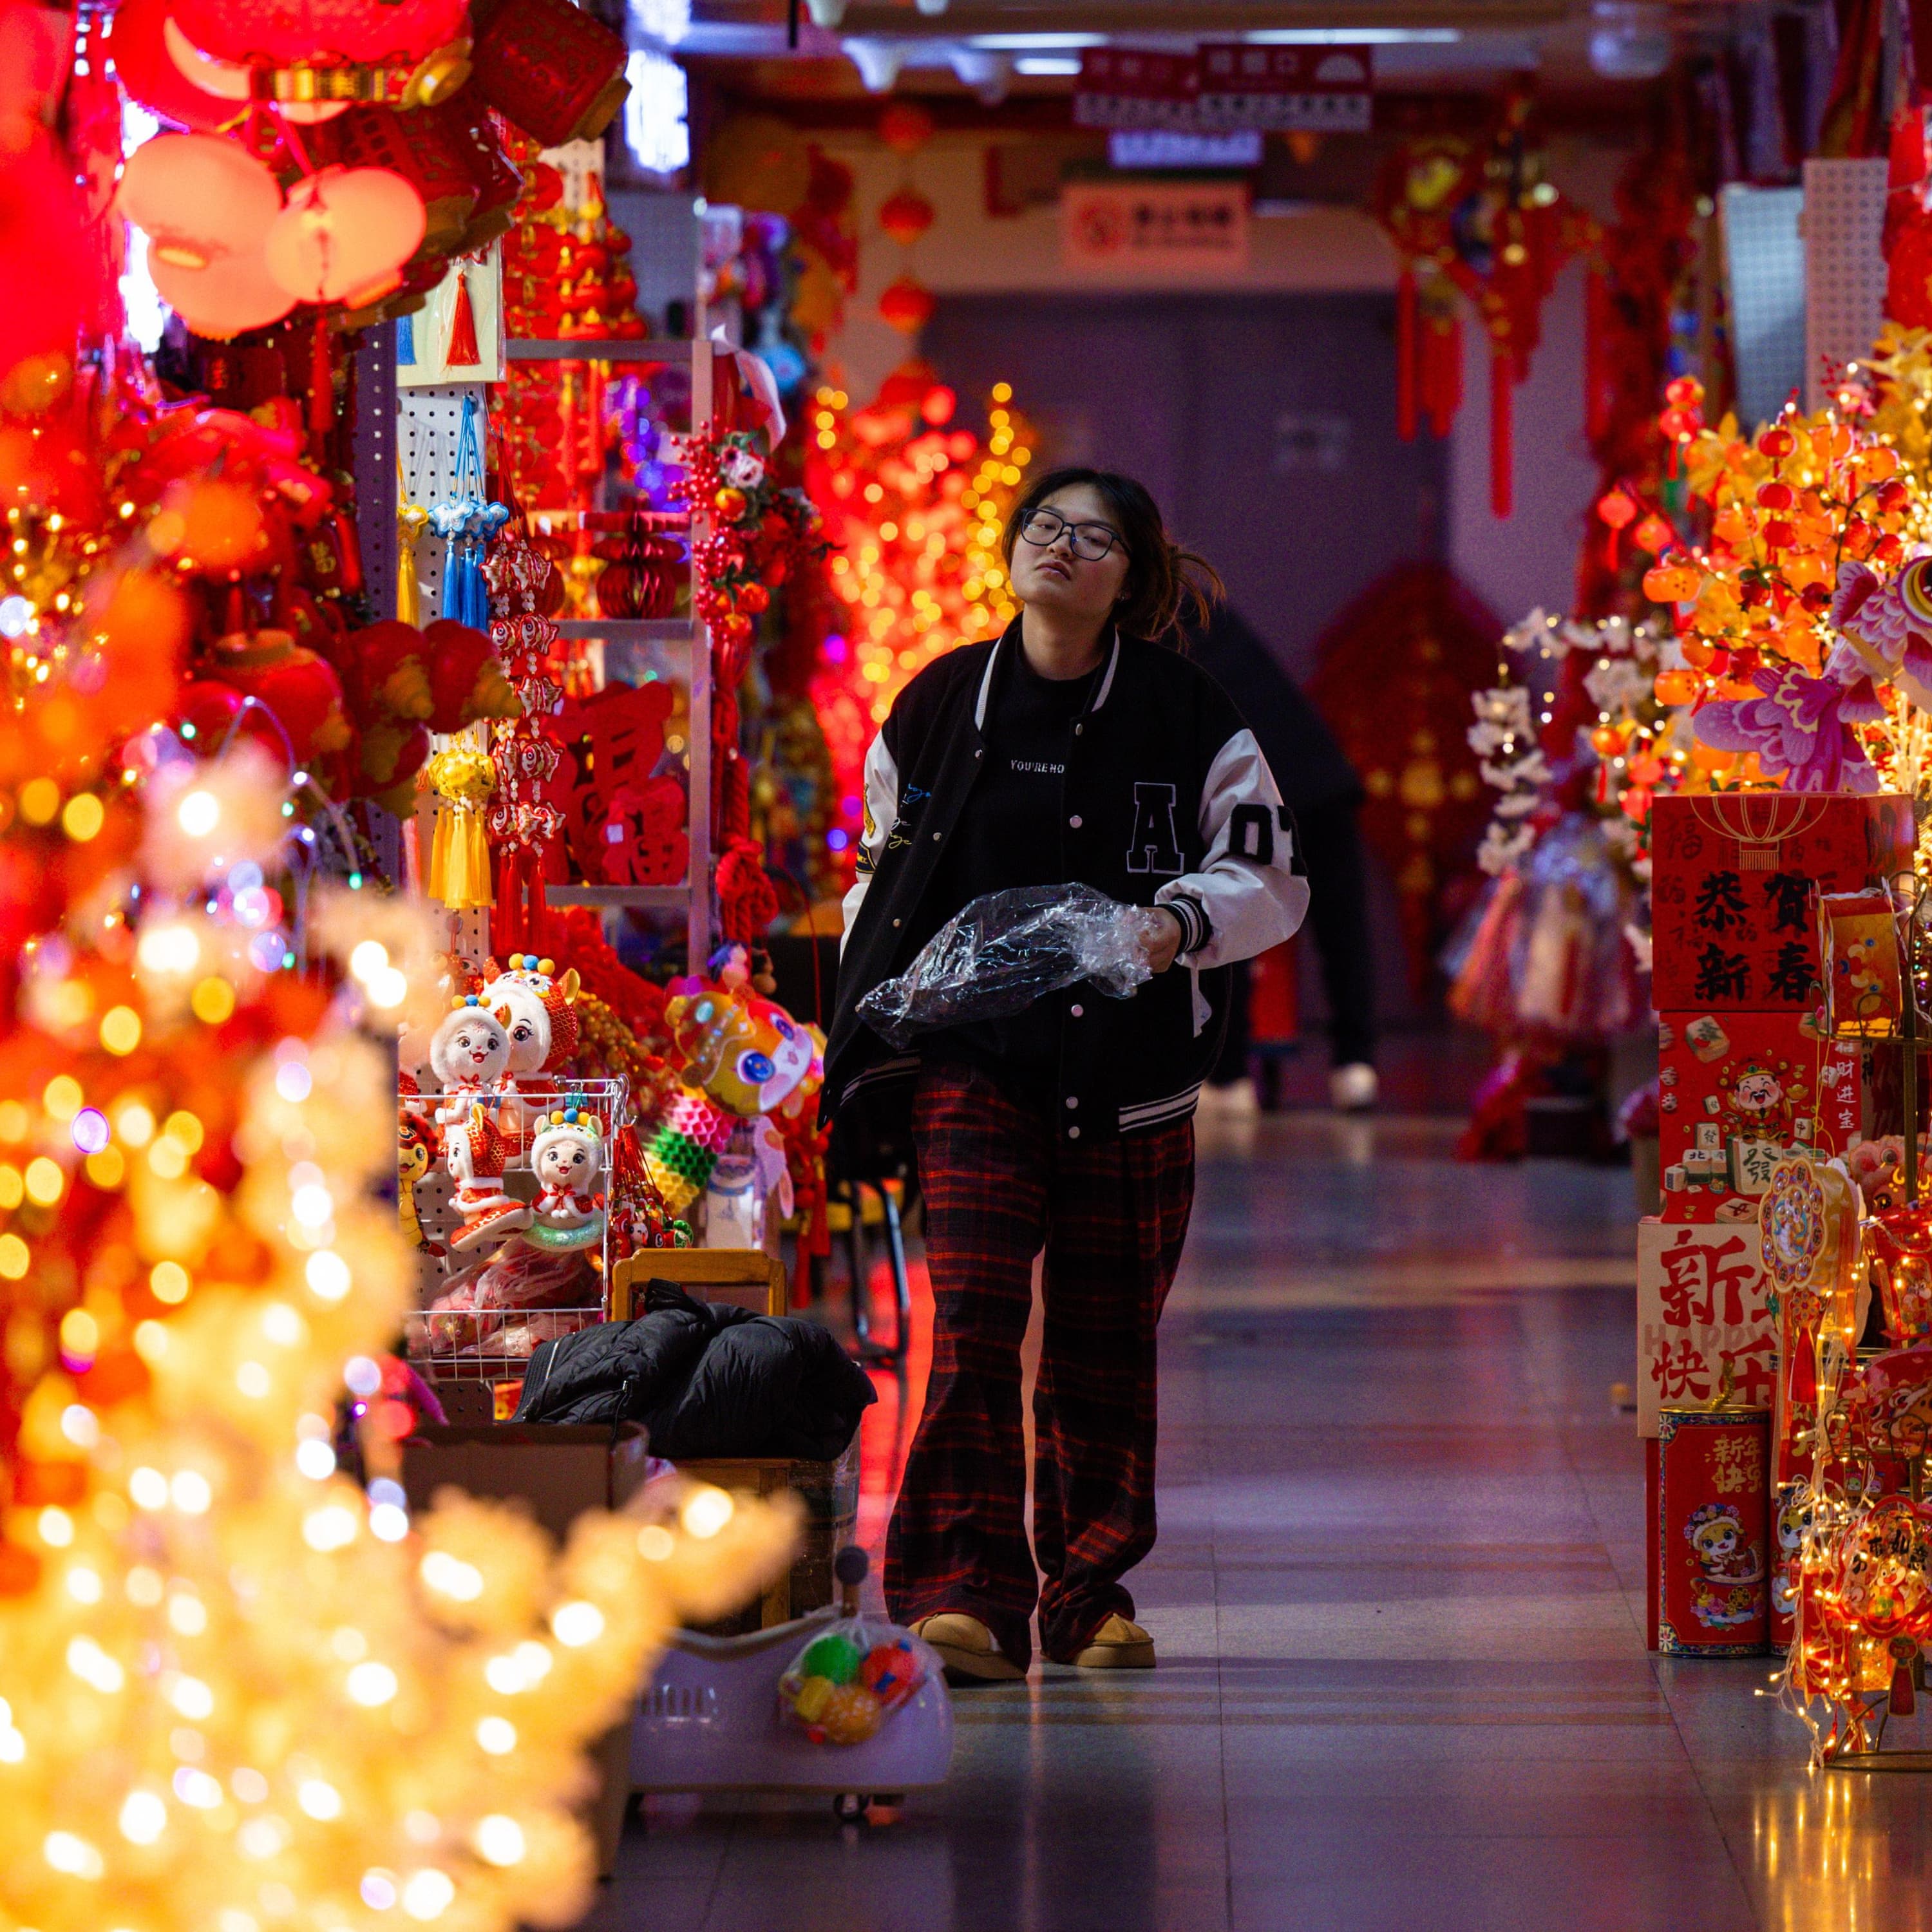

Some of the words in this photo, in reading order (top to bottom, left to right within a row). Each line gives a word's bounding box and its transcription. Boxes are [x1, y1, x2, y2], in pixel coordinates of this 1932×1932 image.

[1127, 782, 1185, 876] A
[1694, 942, 1823, 1003] 新春
[1796, 1121, 1806, 1137] 中
[1743, 1148, 1779, 1185] 發
[1712, 1434, 1761, 1464] 新年
